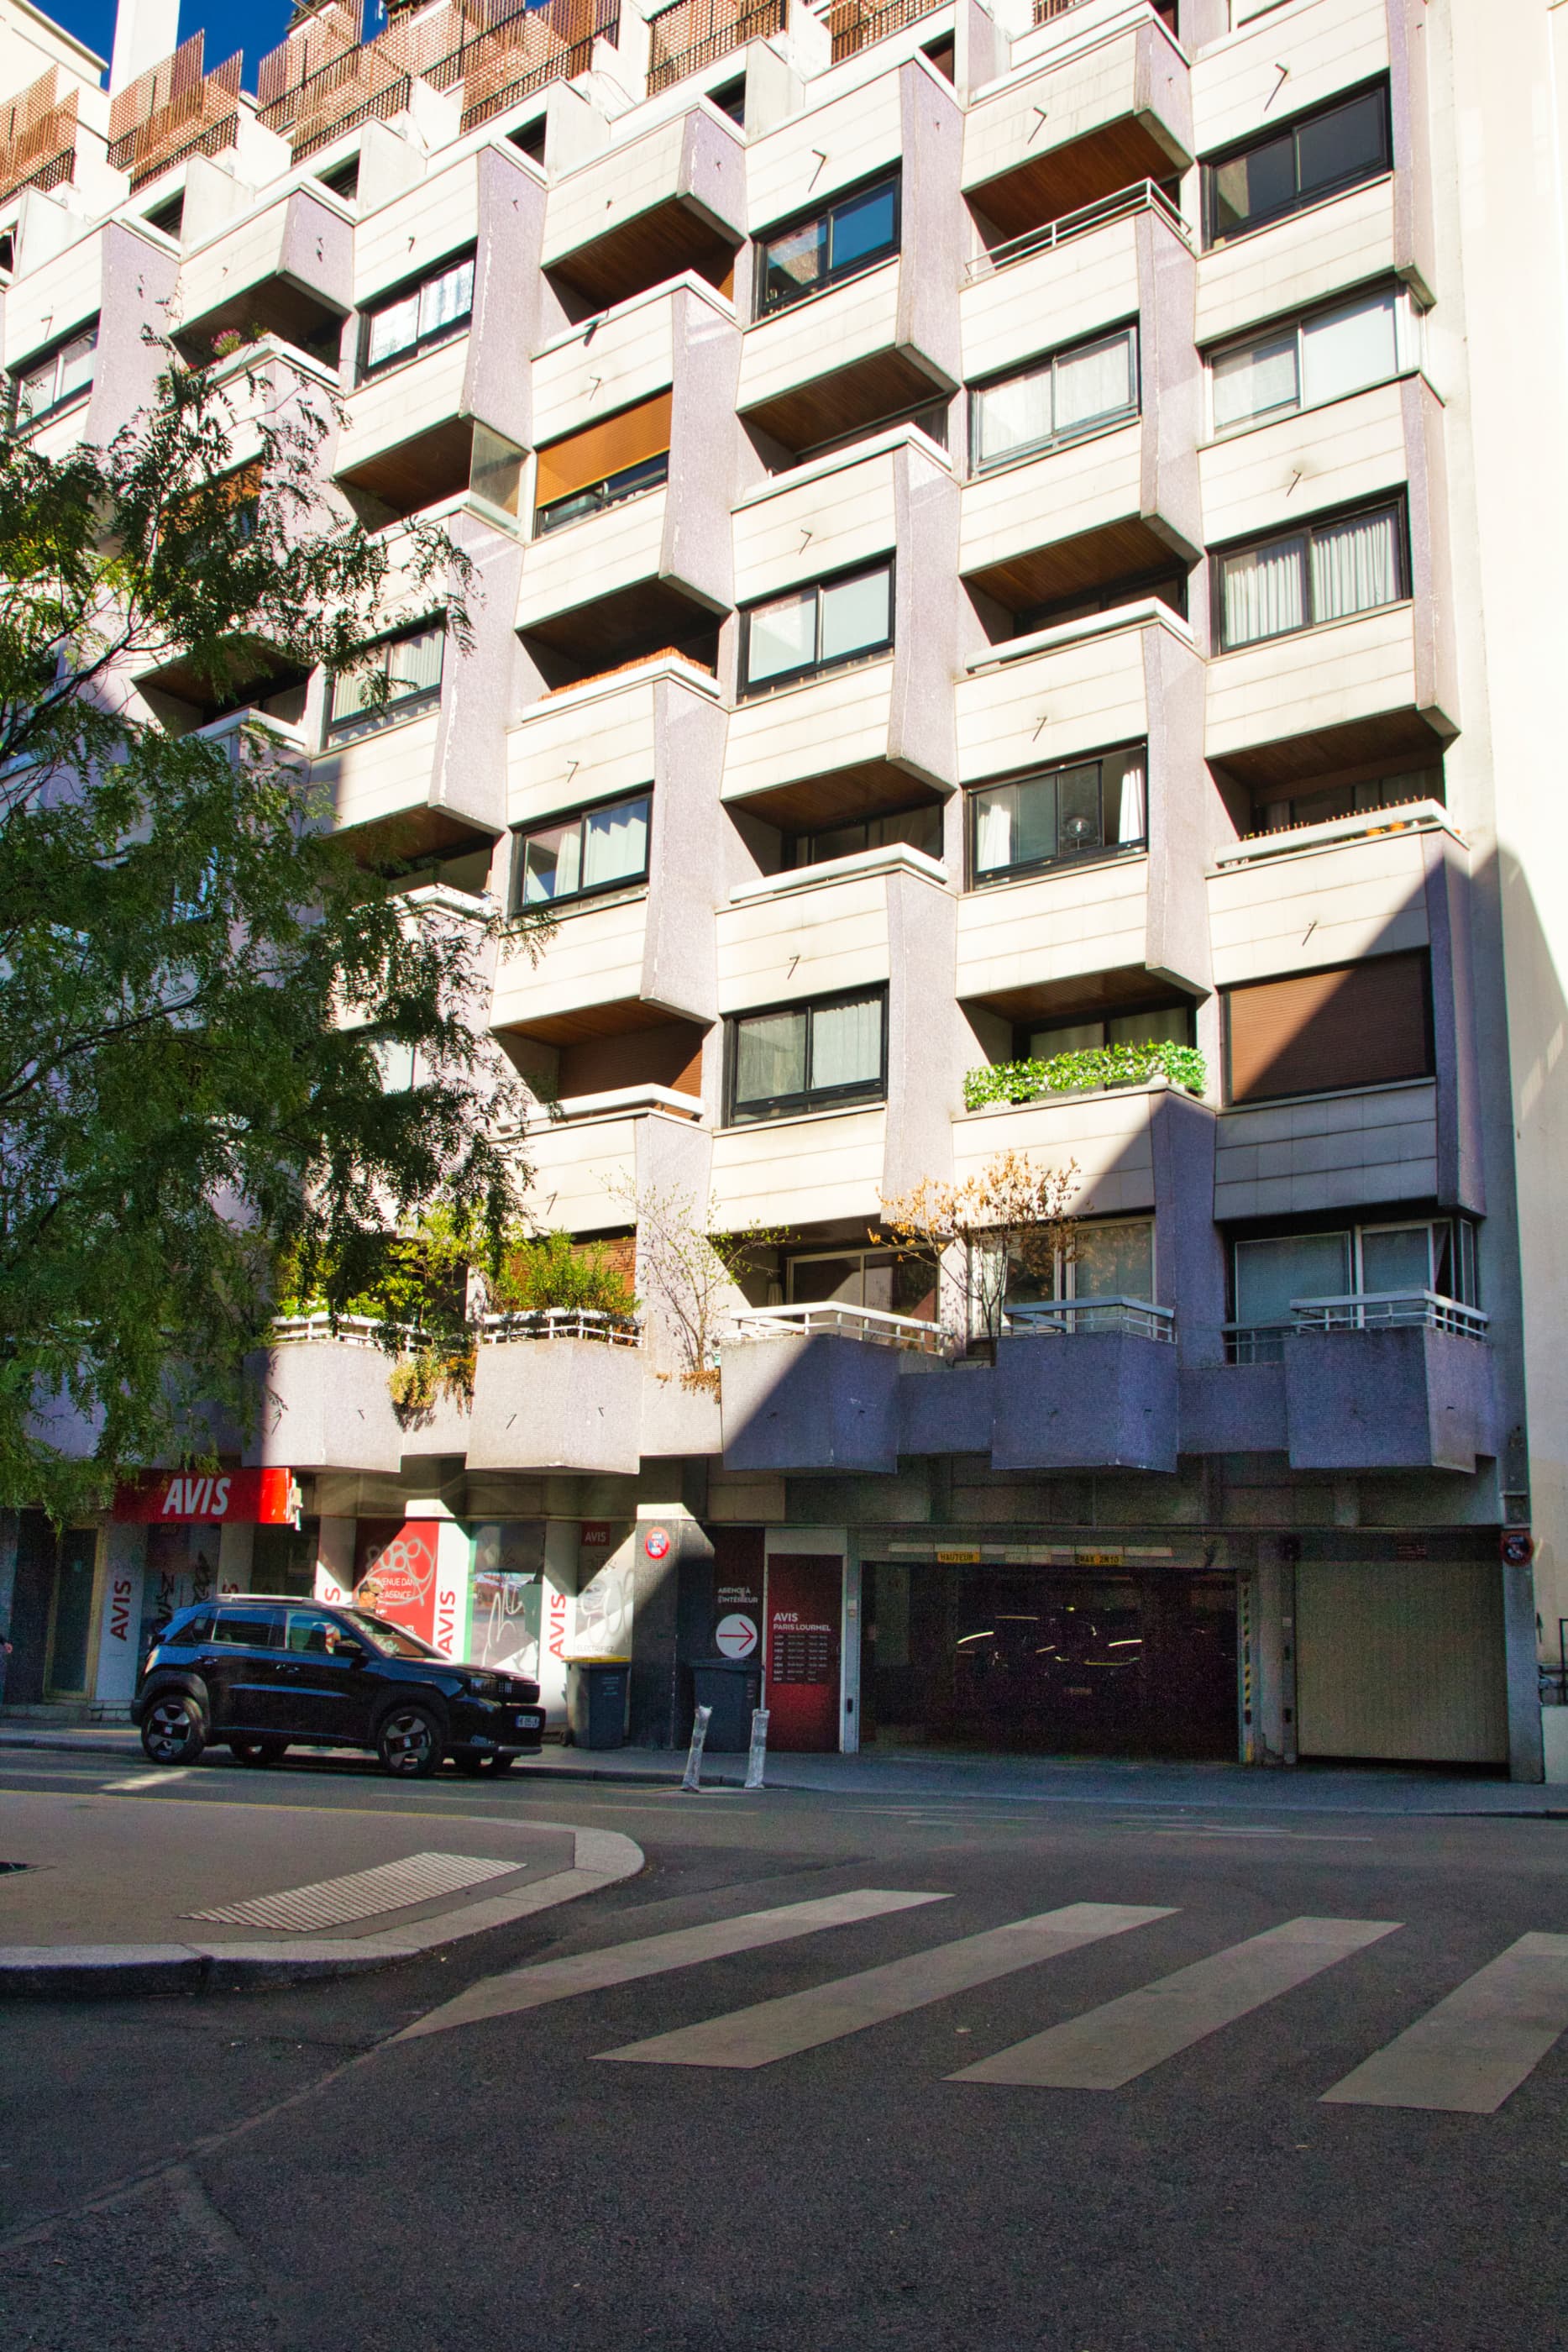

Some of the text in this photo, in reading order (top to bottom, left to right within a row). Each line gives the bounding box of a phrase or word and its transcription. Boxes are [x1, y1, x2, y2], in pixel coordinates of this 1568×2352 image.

[162, 1478, 231, 1515] AVIS
[585, 1531, 606, 1542] AVIS
[940, 1552, 974, 1562] HAUTEUR
[110, 1580, 131, 1641] AVIS
[774, 1612, 799, 1623] AVIS
[438, 1591, 455, 1656] AVIS
[549, 1593, 566, 1661] AVIS
[795, 1624, 831, 1632] LOURMEL
